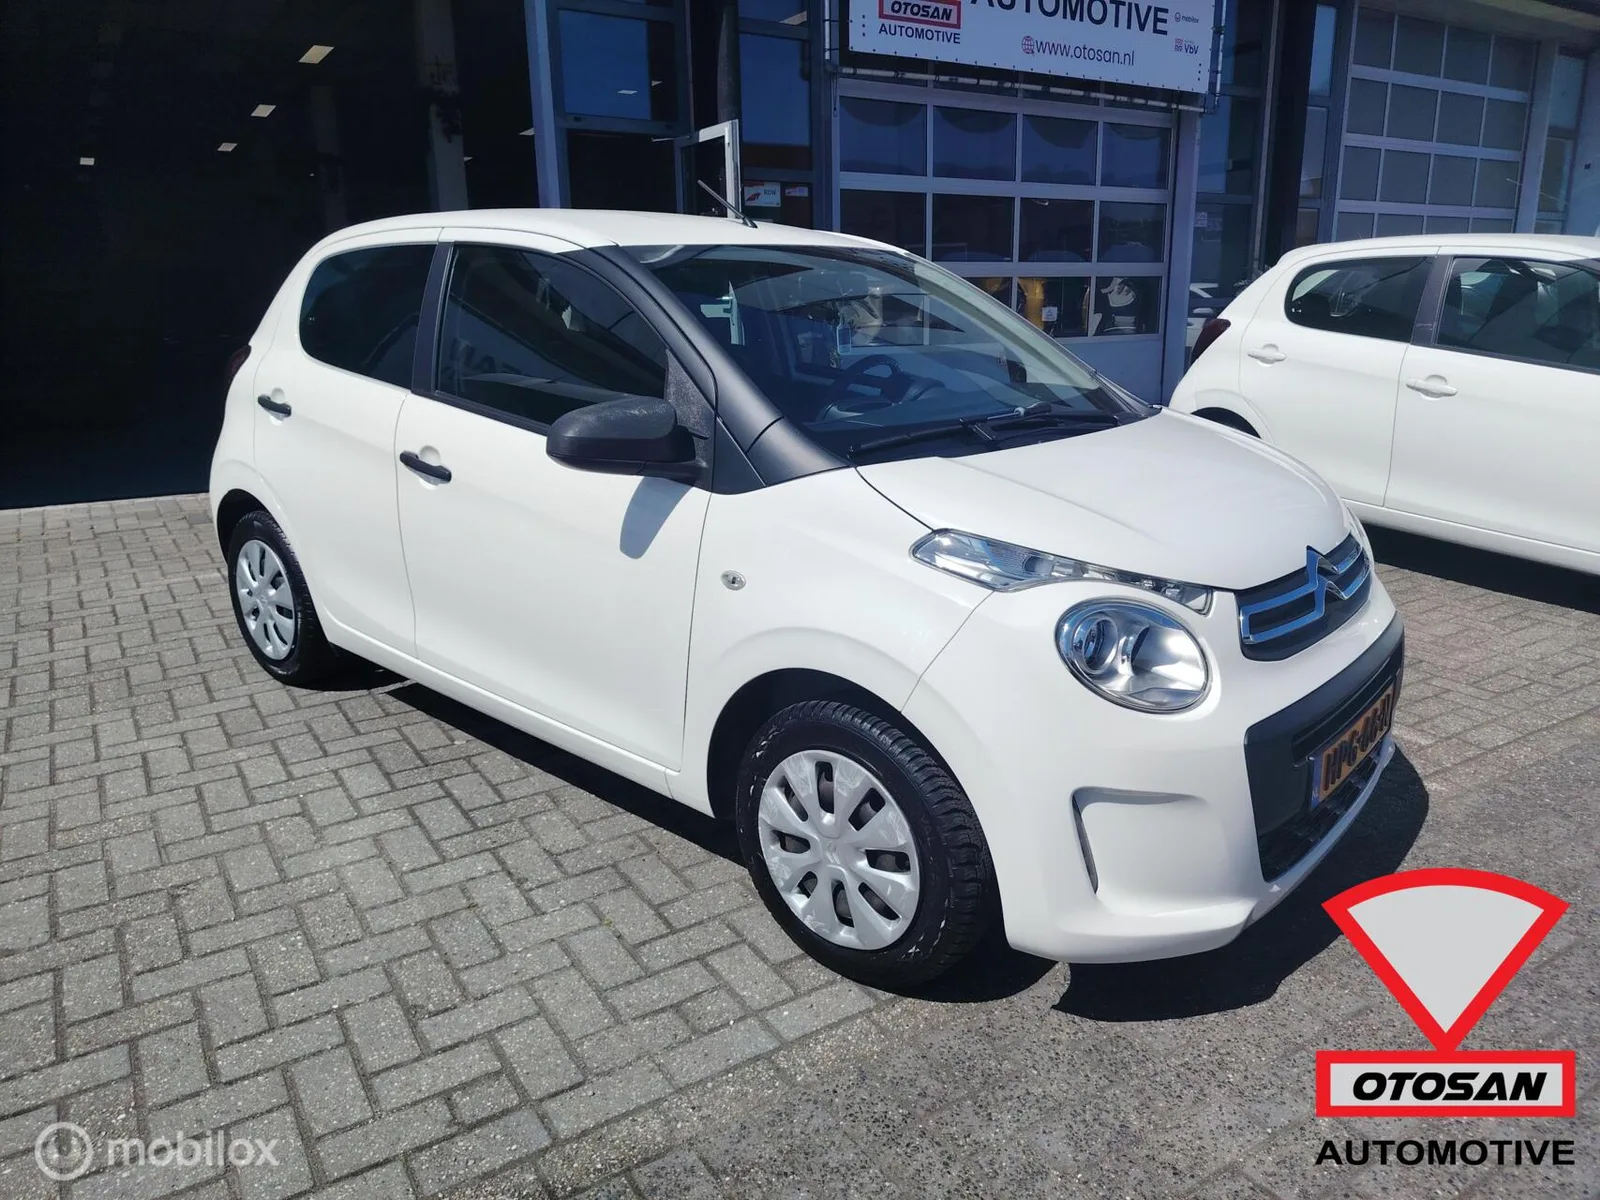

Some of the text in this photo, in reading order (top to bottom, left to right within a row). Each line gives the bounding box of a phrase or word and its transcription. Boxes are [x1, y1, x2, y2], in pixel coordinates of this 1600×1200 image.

[890, 0, 952, 21] OTOSAN
[970, 0, 1169, 36] OMOTIVE
[879, 23, 961, 44] AUTOMOTIVE
[1035, 39, 1135, 66] www.otosan.nl
